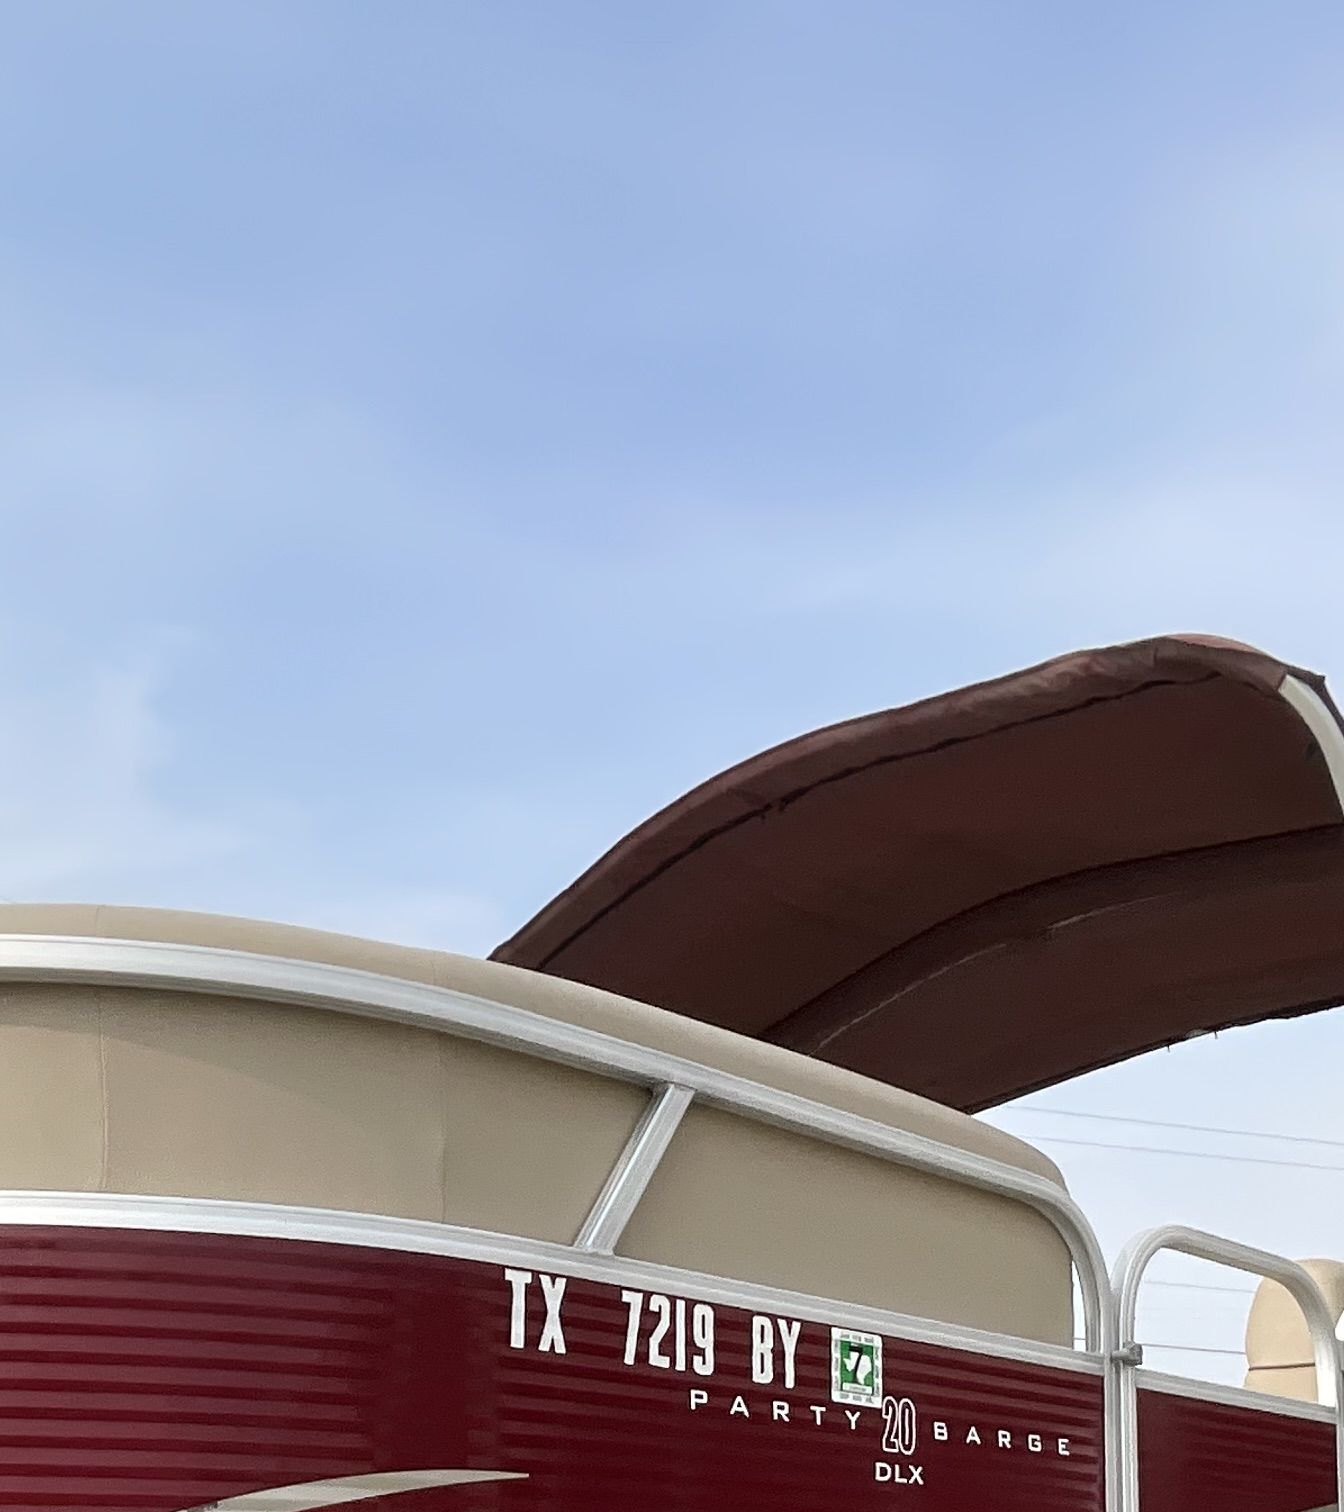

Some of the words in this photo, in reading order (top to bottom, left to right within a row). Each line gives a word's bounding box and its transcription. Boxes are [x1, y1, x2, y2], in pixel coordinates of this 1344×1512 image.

[505, 1268, 567, 1354] TX
[621, 1290, 714, 1376] 7219
[752, 1315, 801, 1389] BY
[690, 1389, 860, 1430] PARTY
[882, 1396, 916, 1455] 20
[934, 1422, 1070, 1456] BARGE
[875, 1462, 923, 1485] DLX
